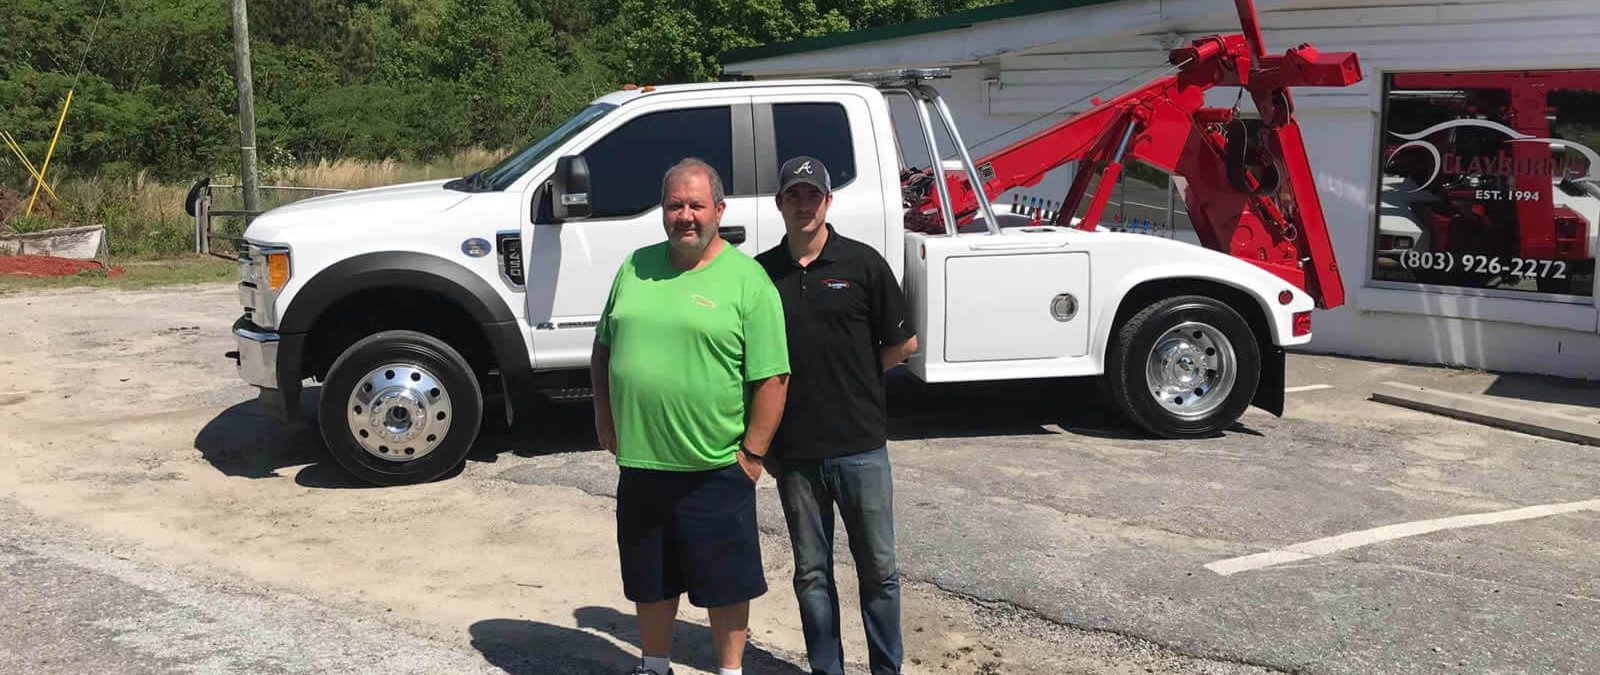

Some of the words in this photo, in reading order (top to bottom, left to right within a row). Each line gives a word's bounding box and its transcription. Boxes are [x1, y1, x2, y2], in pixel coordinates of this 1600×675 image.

[793, 161, 813, 174] A
[1475, 190, 1503, 200] EST.
[1508, 190, 1540, 201] 1994
[1400, 251, 1454, 272] (803)
[1462, 254, 1567, 279] 926-2272
